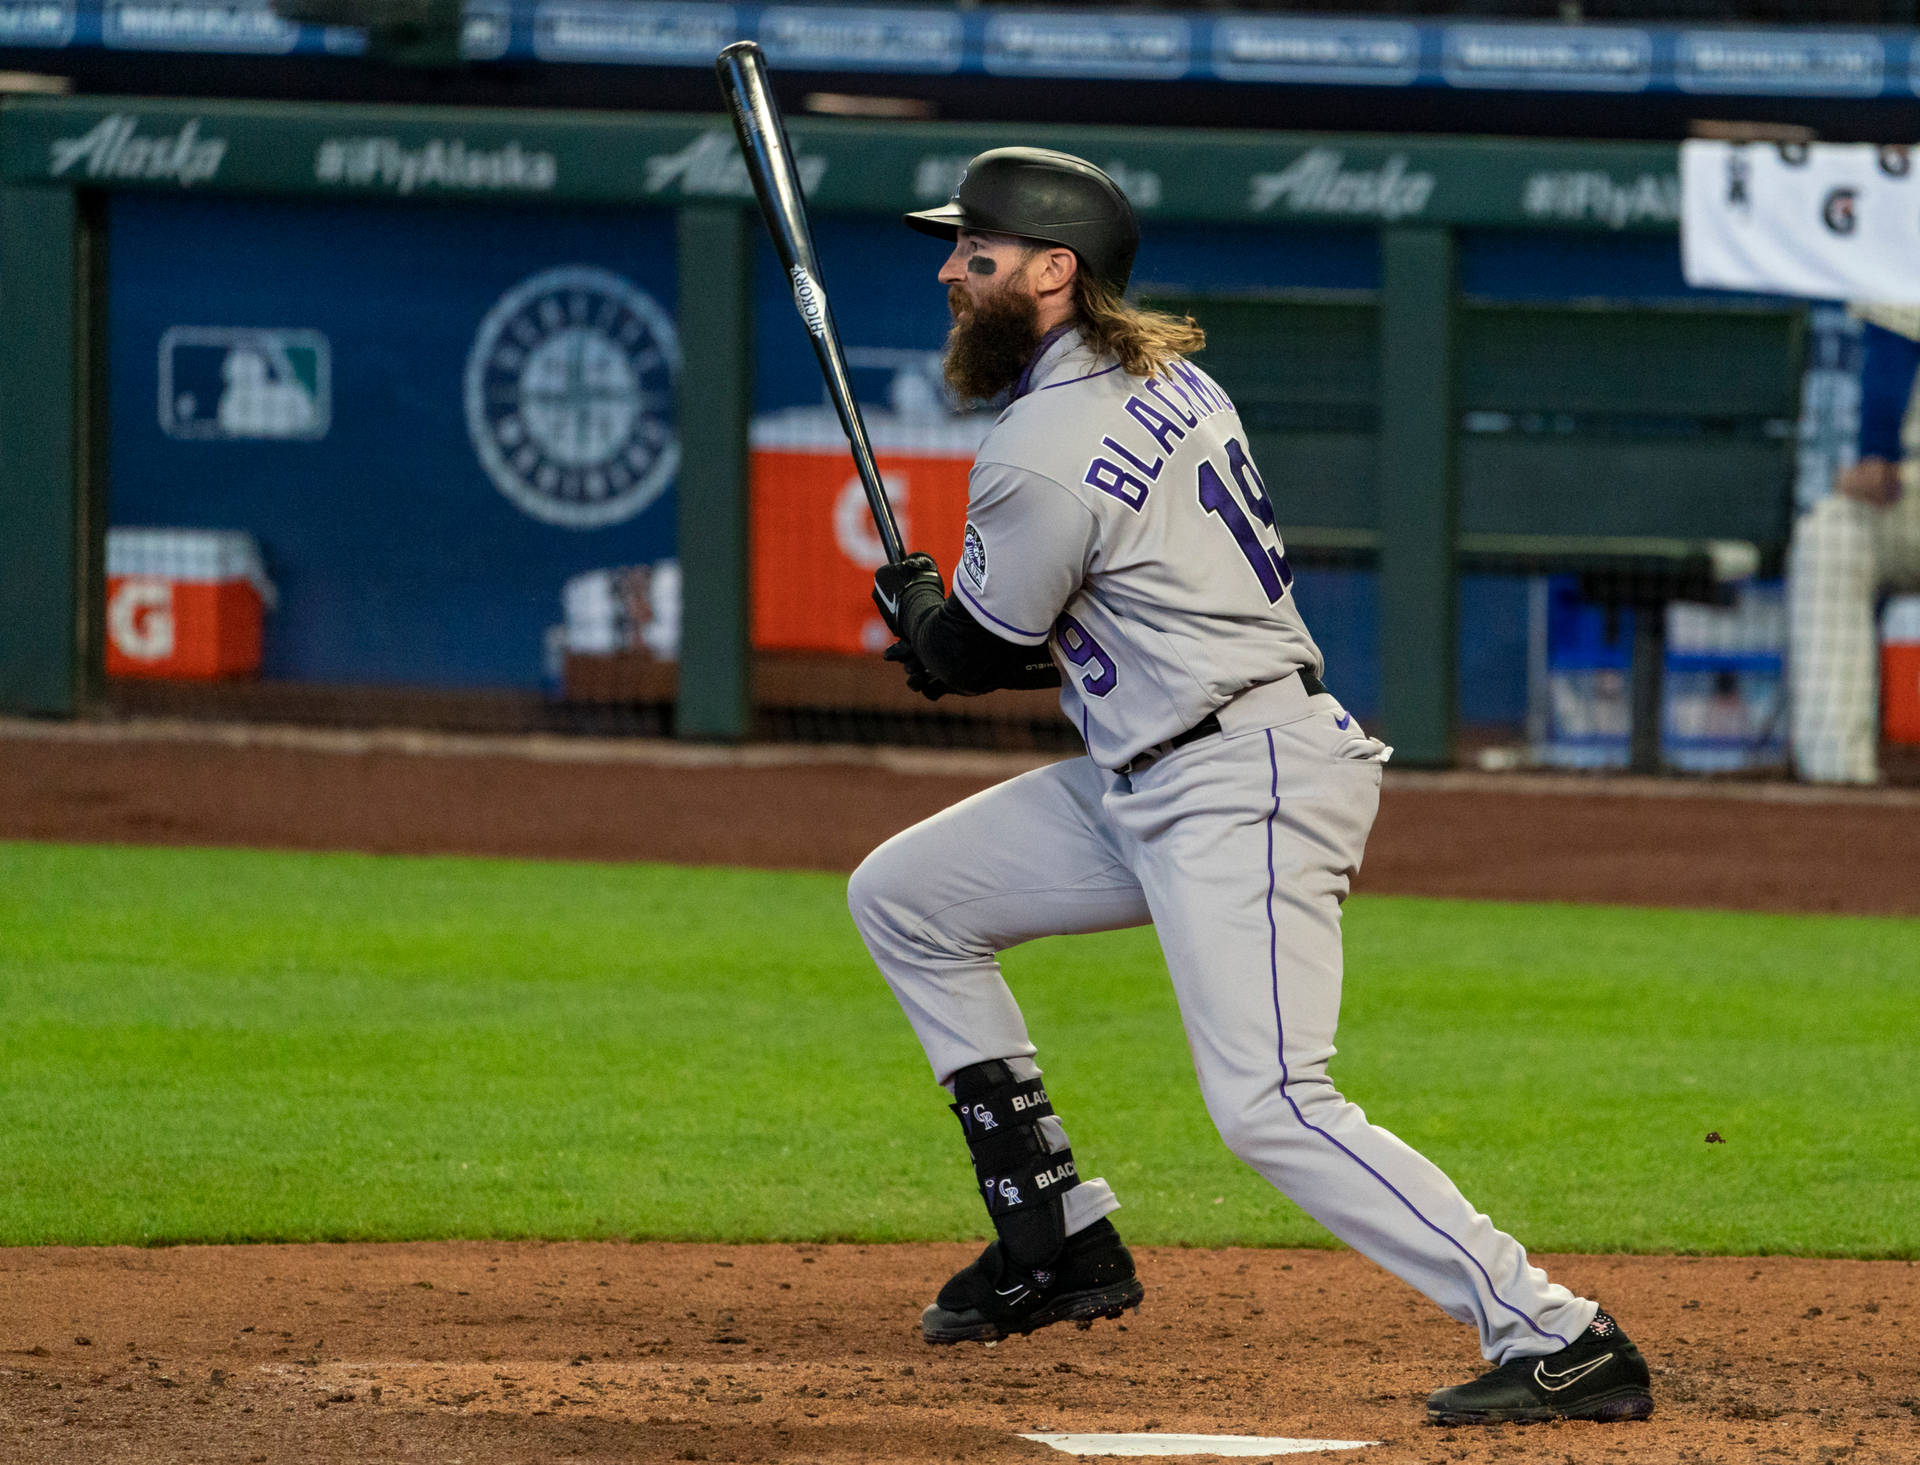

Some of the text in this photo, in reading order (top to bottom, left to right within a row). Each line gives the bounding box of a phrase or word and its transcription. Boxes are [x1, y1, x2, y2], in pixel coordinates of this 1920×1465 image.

[50, 114, 227, 188] Alaska
[643, 132, 828, 197] Alaa
[1250, 149, 1435, 219] Alaska
[790, 267, 825, 335] HICKORY
[1197, 436, 1294, 608] 19
[111, 582, 175, 660] G
[1055, 610, 1119, 700] 9
[1034, 1161, 1076, 1190] BLAC
